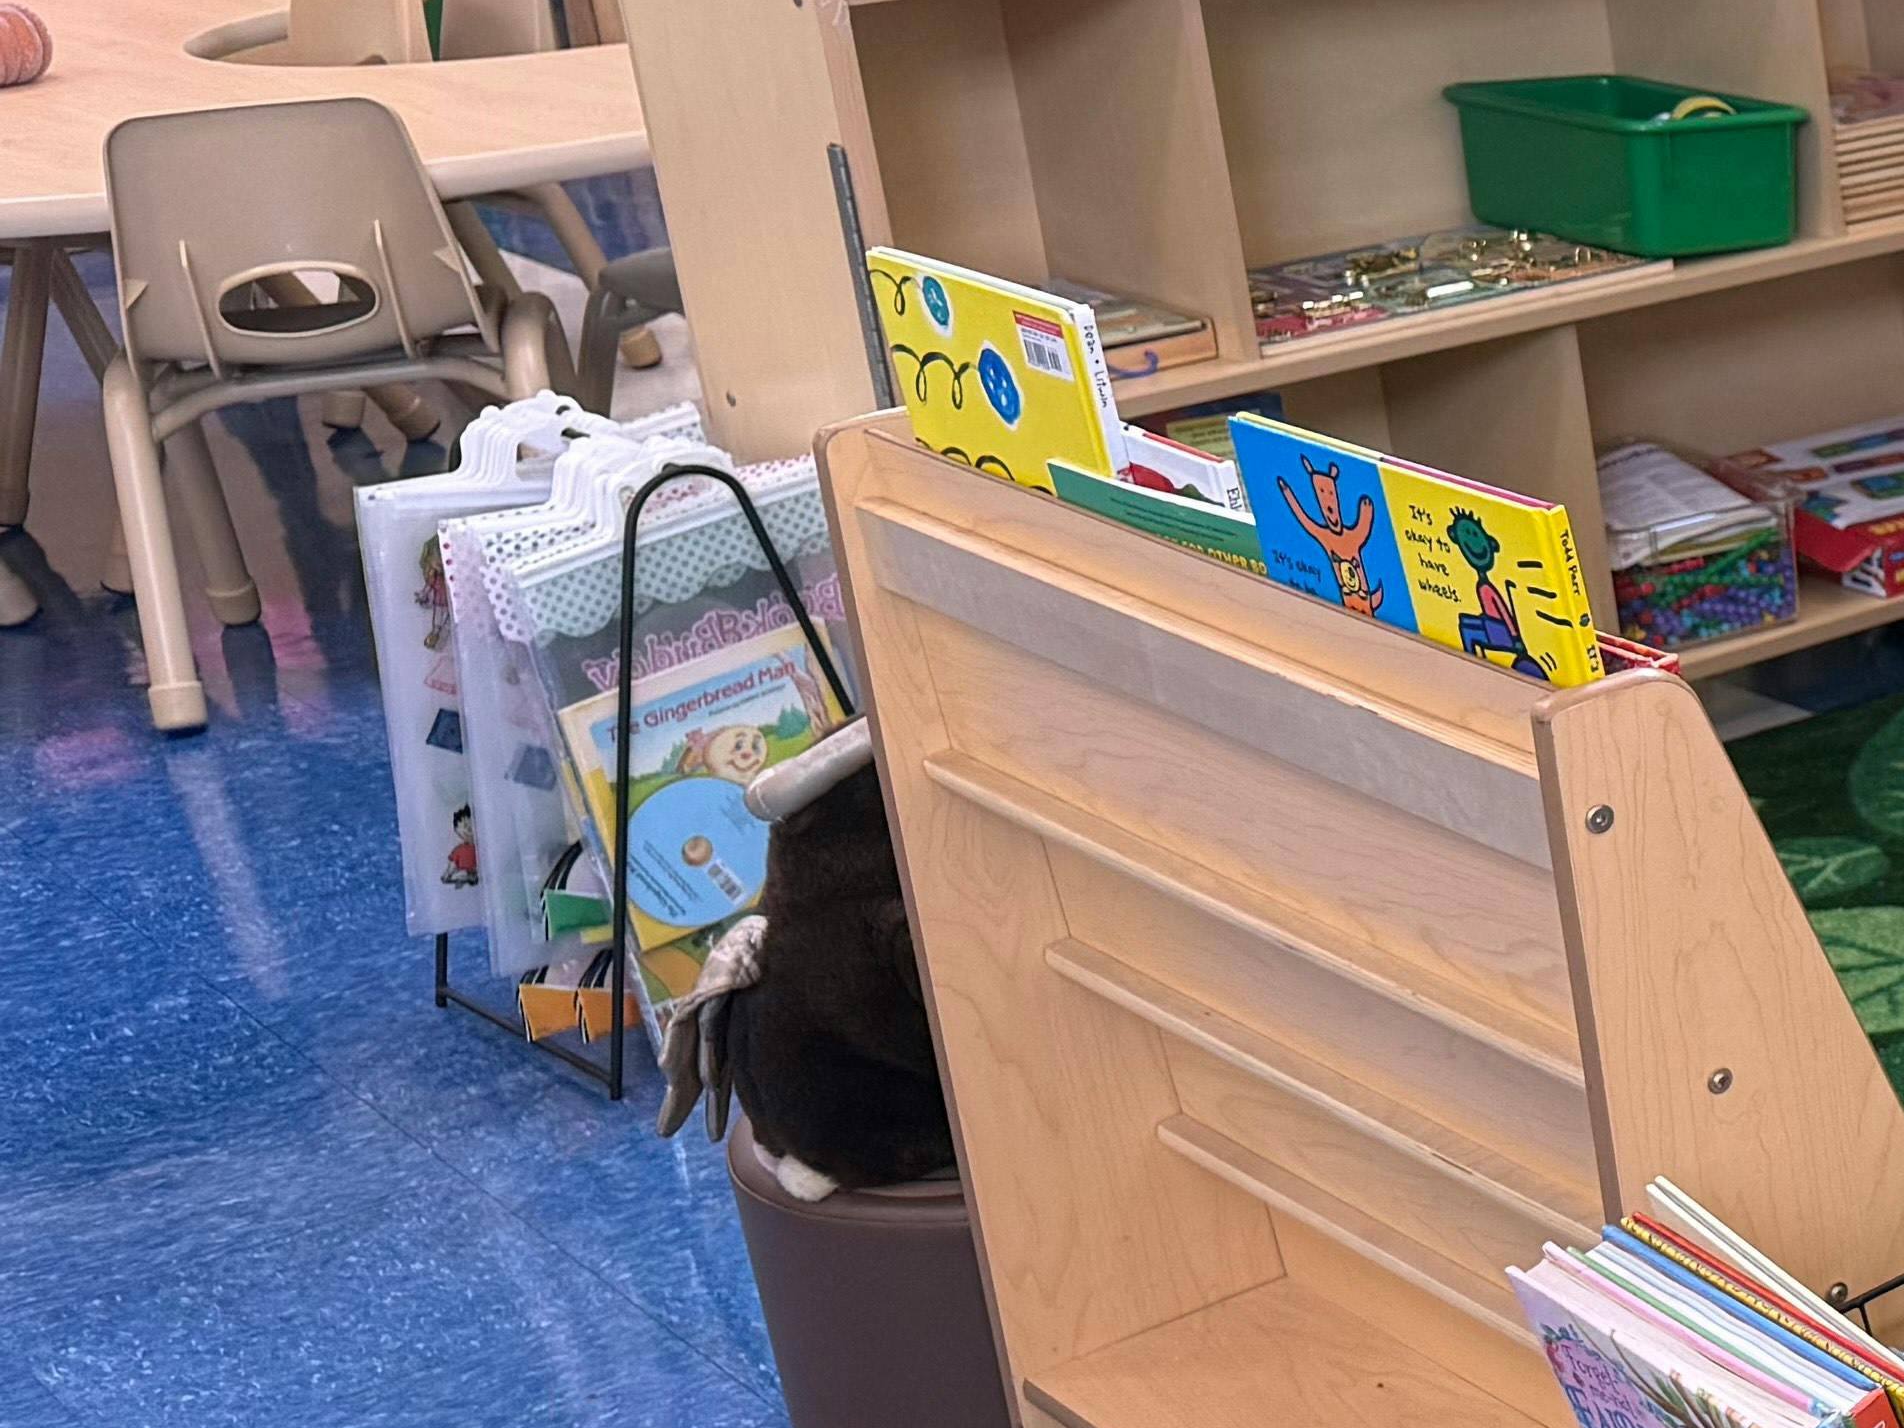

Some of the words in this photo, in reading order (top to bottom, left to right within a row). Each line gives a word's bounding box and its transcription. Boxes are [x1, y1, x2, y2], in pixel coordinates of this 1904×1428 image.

[1408, 504, 1433, 526] It's
[1405, 529, 1434, 553] okay
[1436, 534, 1451, 554] to
[1560, 529, 1574, 563] Todd
[1418, 552, 1450, 577] have
[606, 717, 641, 743] Te
[643, 675, 755, 727] Gingerbread
[758, 660, 796, 686] Man
